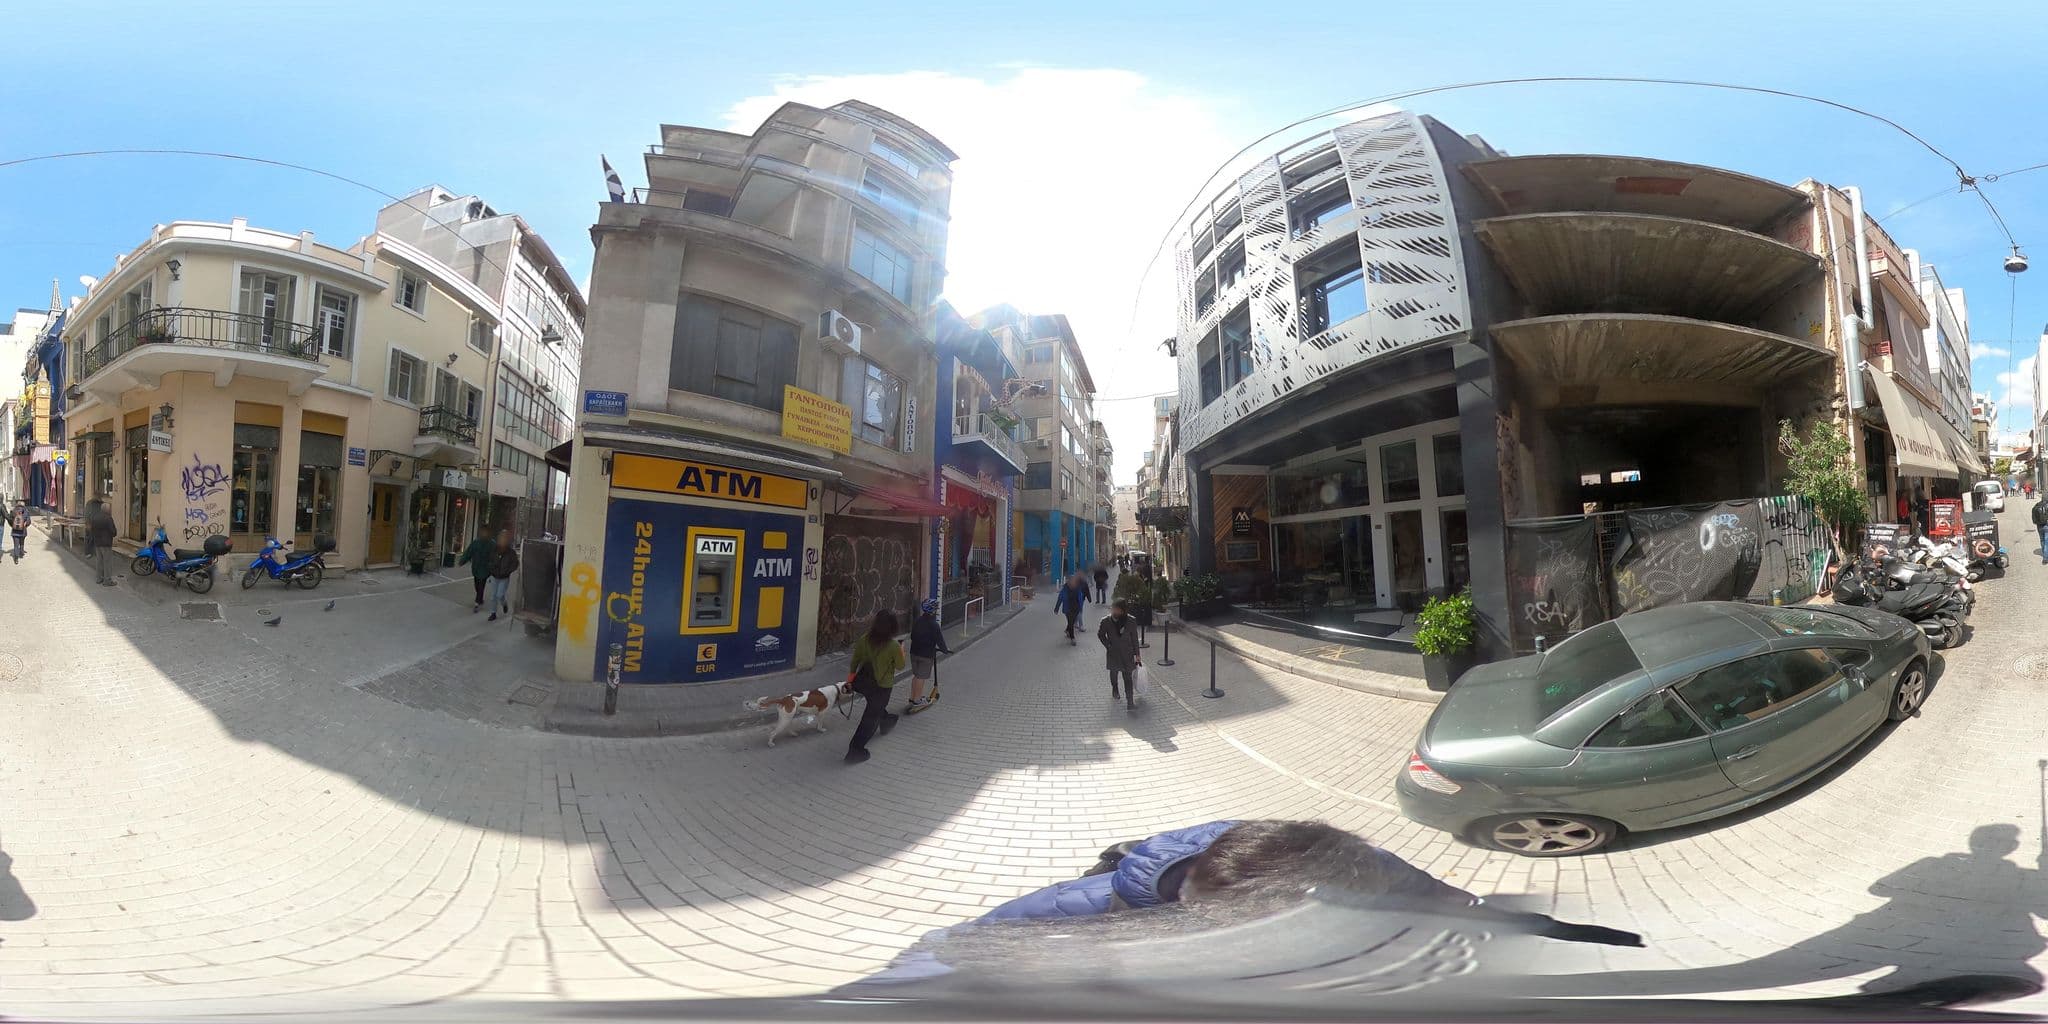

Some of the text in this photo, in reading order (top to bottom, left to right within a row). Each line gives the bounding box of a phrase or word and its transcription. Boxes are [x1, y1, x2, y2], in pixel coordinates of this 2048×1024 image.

[676, 466, 762, 498] ATM
[701, 541, 733, 553] ATM
[753, 558, 792, 578] ATM
[624, 622, 645, 672] ATM
[696, 663, 716, 673] EUR
